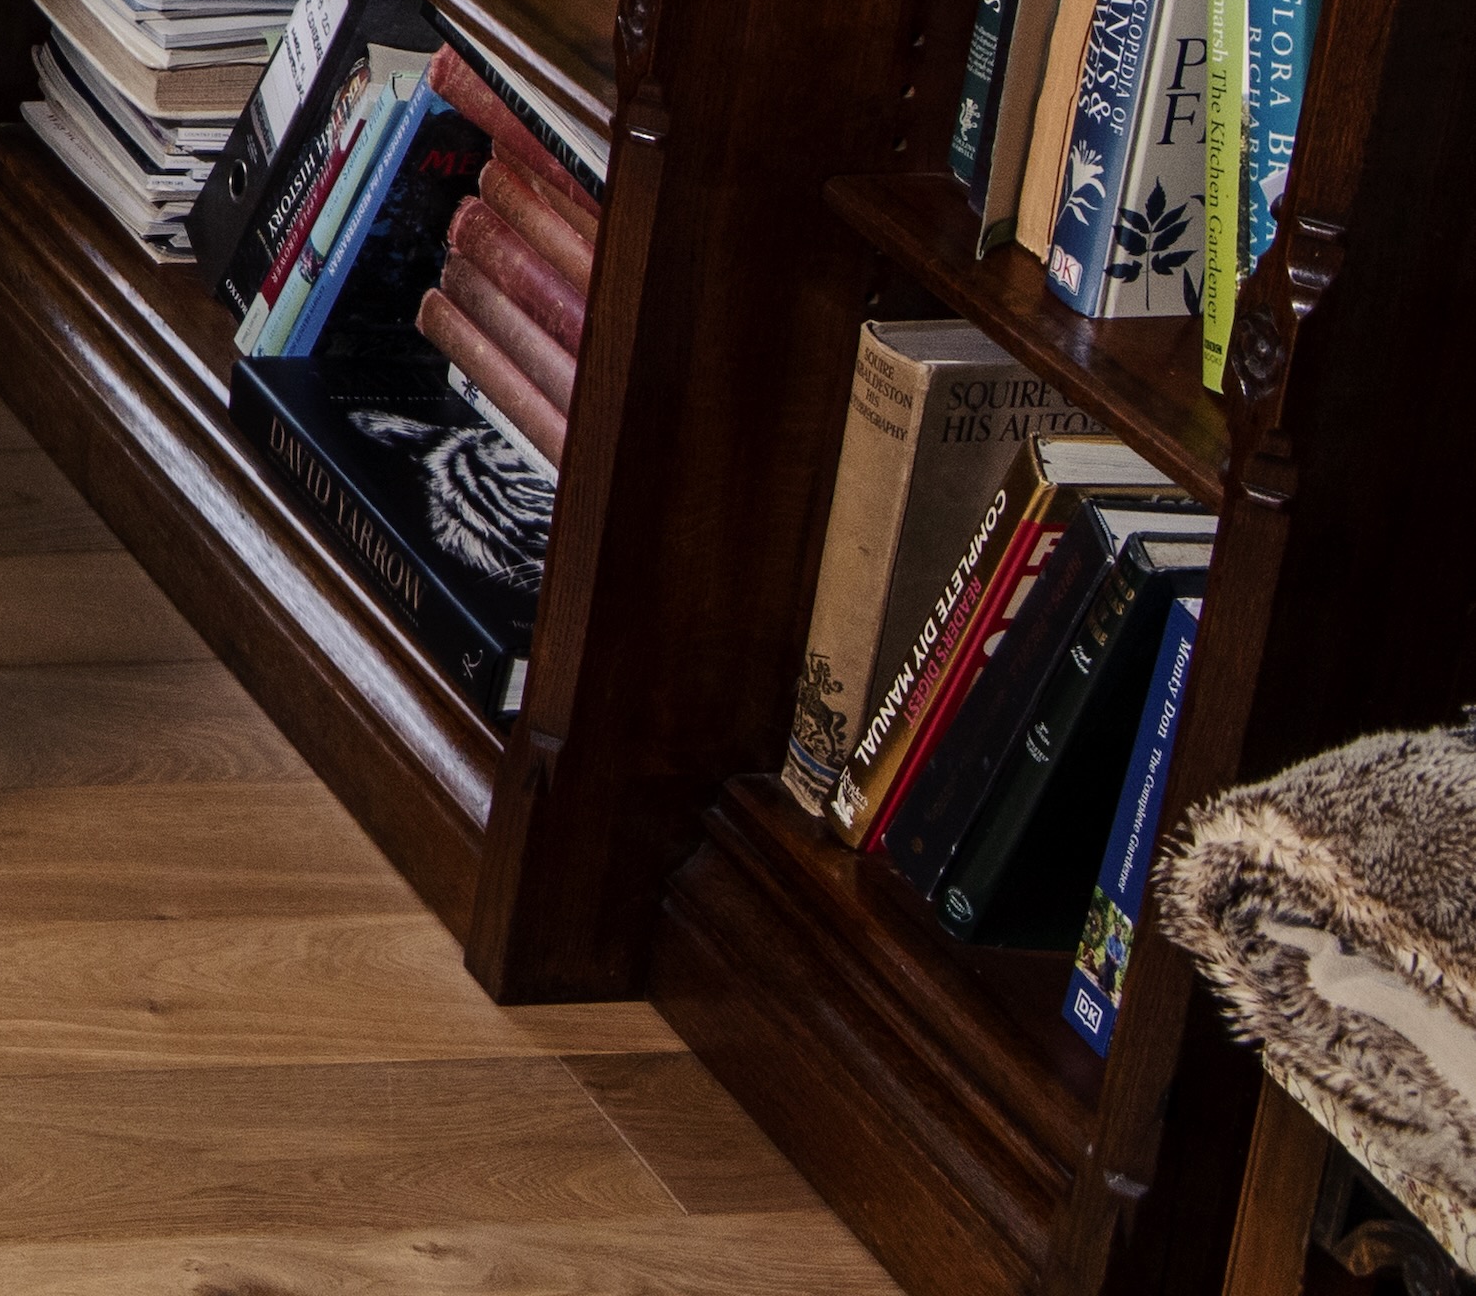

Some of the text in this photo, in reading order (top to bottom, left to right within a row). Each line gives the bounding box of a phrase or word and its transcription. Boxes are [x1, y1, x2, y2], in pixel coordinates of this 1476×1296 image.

[1088, 93, 1112, 125] &
[1109, 105, 1128, 137] OF
[1210, 69, 1228, 116] The
[1248, 26, 1262, 183] RICHARD
[320, 81, 429, 277] VILLA GARDENS MEDITERRANEAN
[335, 130, 372, 182] Flowers
[1208, 117, 1226, 209] Kitchen
[262, 151, 320, 238] HISTORY
[263, 189, 322, 289] APPLE GROWER
[1051, 247, 1080, 294] DK
[1206, 215, 1224, 325] Gardener
[863, 346, 895, 381] SQUIRE
[949, 379, 1054, 410] SQUIRE
[865, 388, 881, 409] HIS
[941, 416, 992, 445] HIS
[270, 414, 332, 507] DAVID
[335, 486, 427, 611] YARROW
[853, 488, 1007, 767] COMPLETE DIY MANUAL
[905, 575, 983, 728] READER'S DIGEST
[1116, 636, 1193, 895] Monty Don The Complete Gardener
[1078, 994, 1099, 1026] DK
